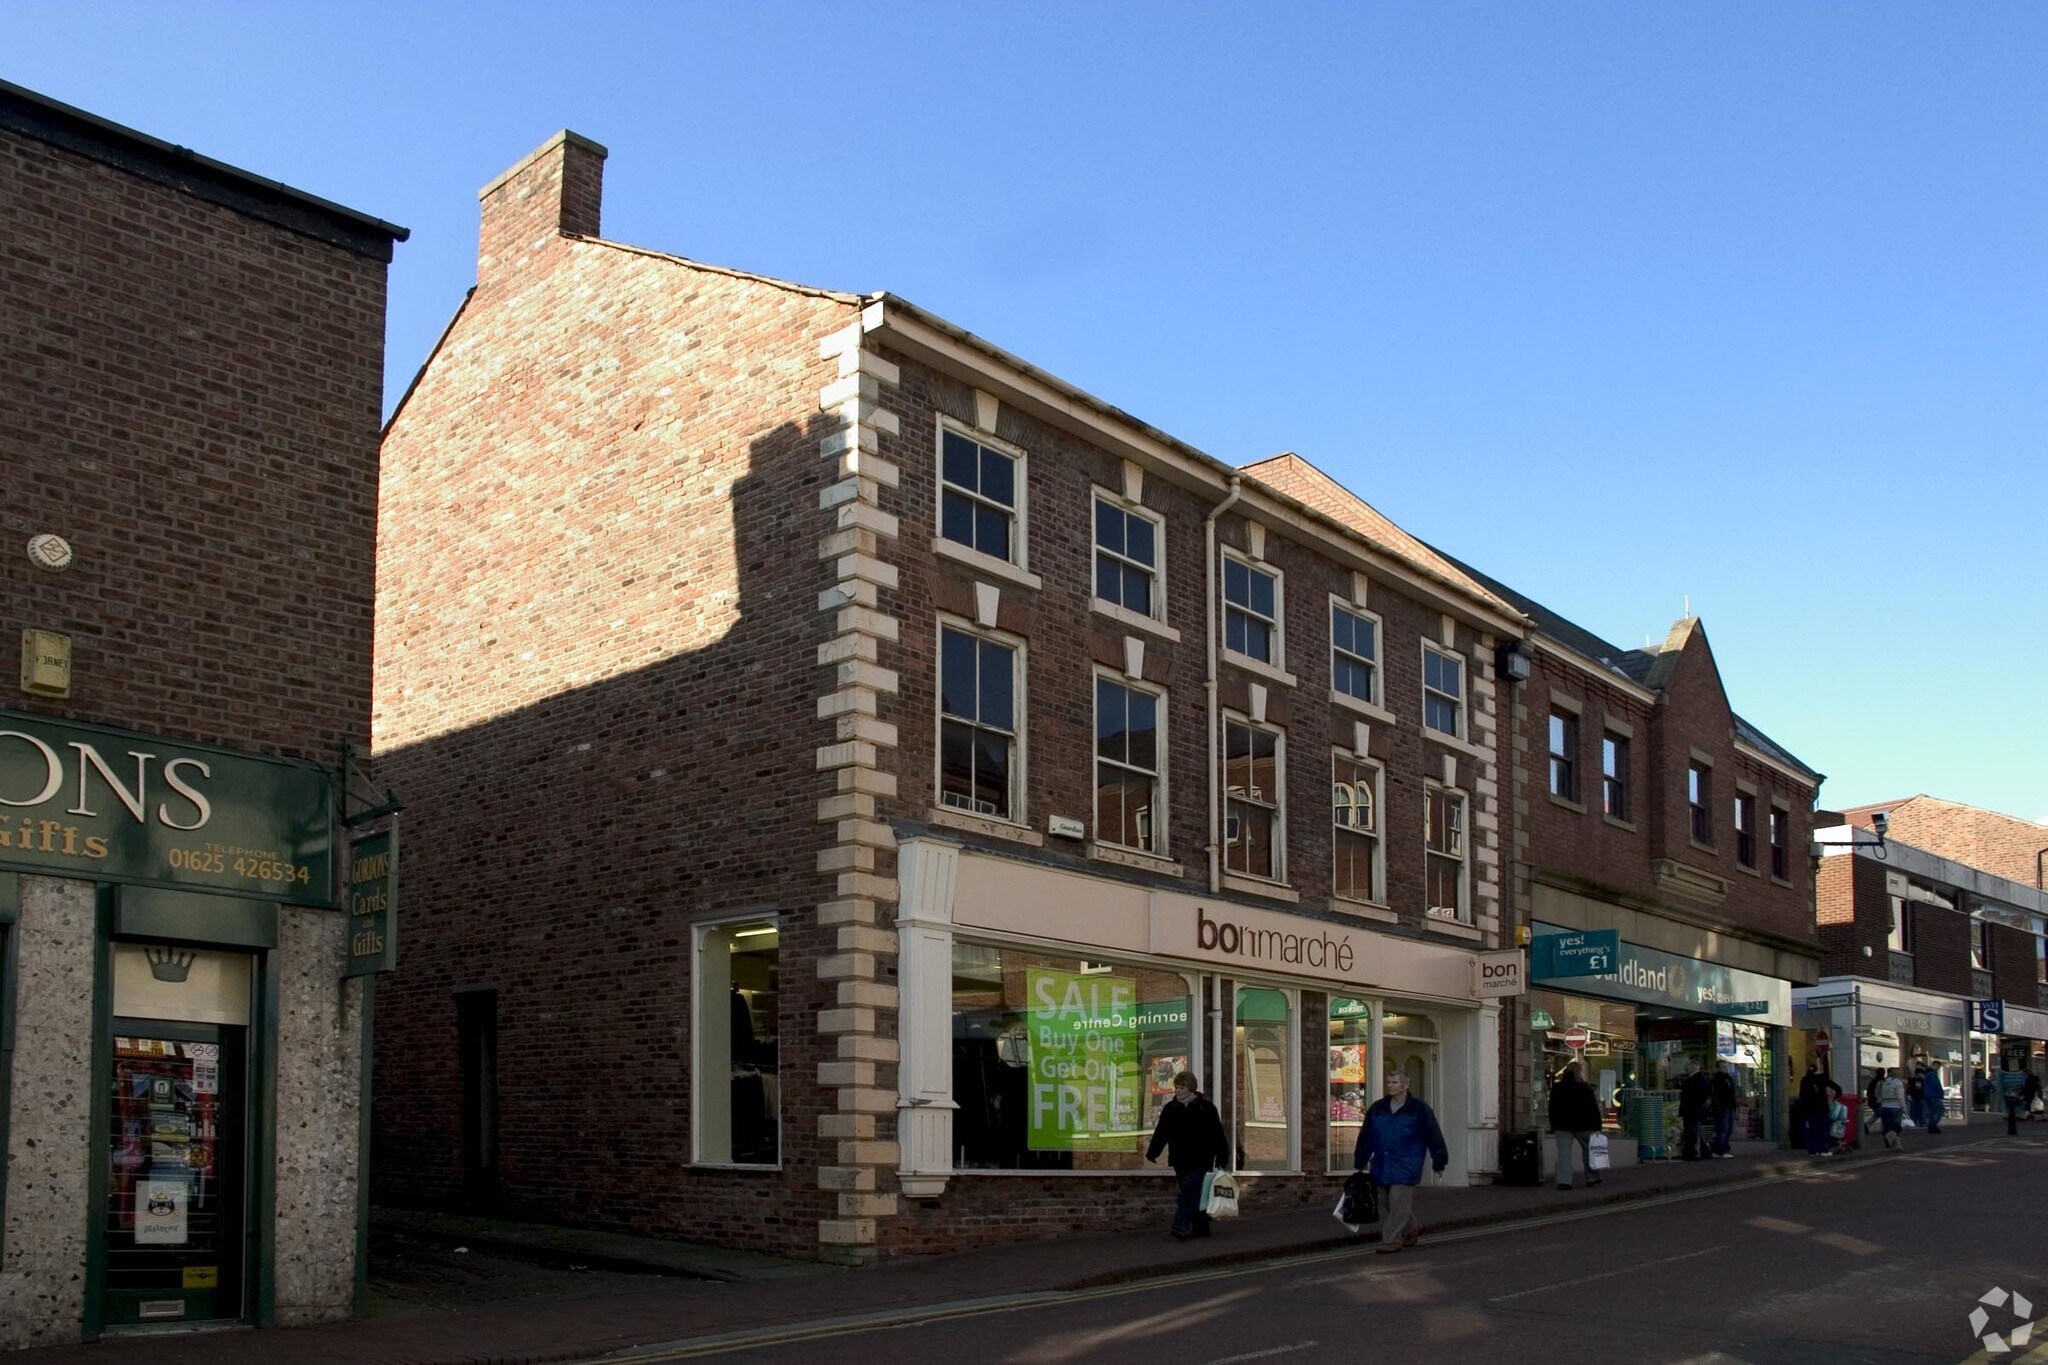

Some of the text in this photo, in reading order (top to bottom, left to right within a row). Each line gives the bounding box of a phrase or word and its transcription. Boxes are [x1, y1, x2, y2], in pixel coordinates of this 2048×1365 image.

[204, 842, 280, 861] TELEPHONE
[168, 848, 310, 885] 01625 426534
[352, 886, 387, 917] Cards
[1560, 935, 1584, 949] yes!
[1560, 945, 1611, 956] everything's
[1482, 962, 1517, 978] bon
[1589, 955, 1608, 969] £1
[1483, 977, 1517, 988] marché
[1035, 977, 1129, 1027] SALE
[1697, 985, 1716, 1003] yes!
[1983, 1008, 2000, 1031] S
[1039, 1025, 1124, 1055] Buy One
[1041, 1056, 1124, 1081] Get One
[1033, 1083, 1132, 1131] FREE
